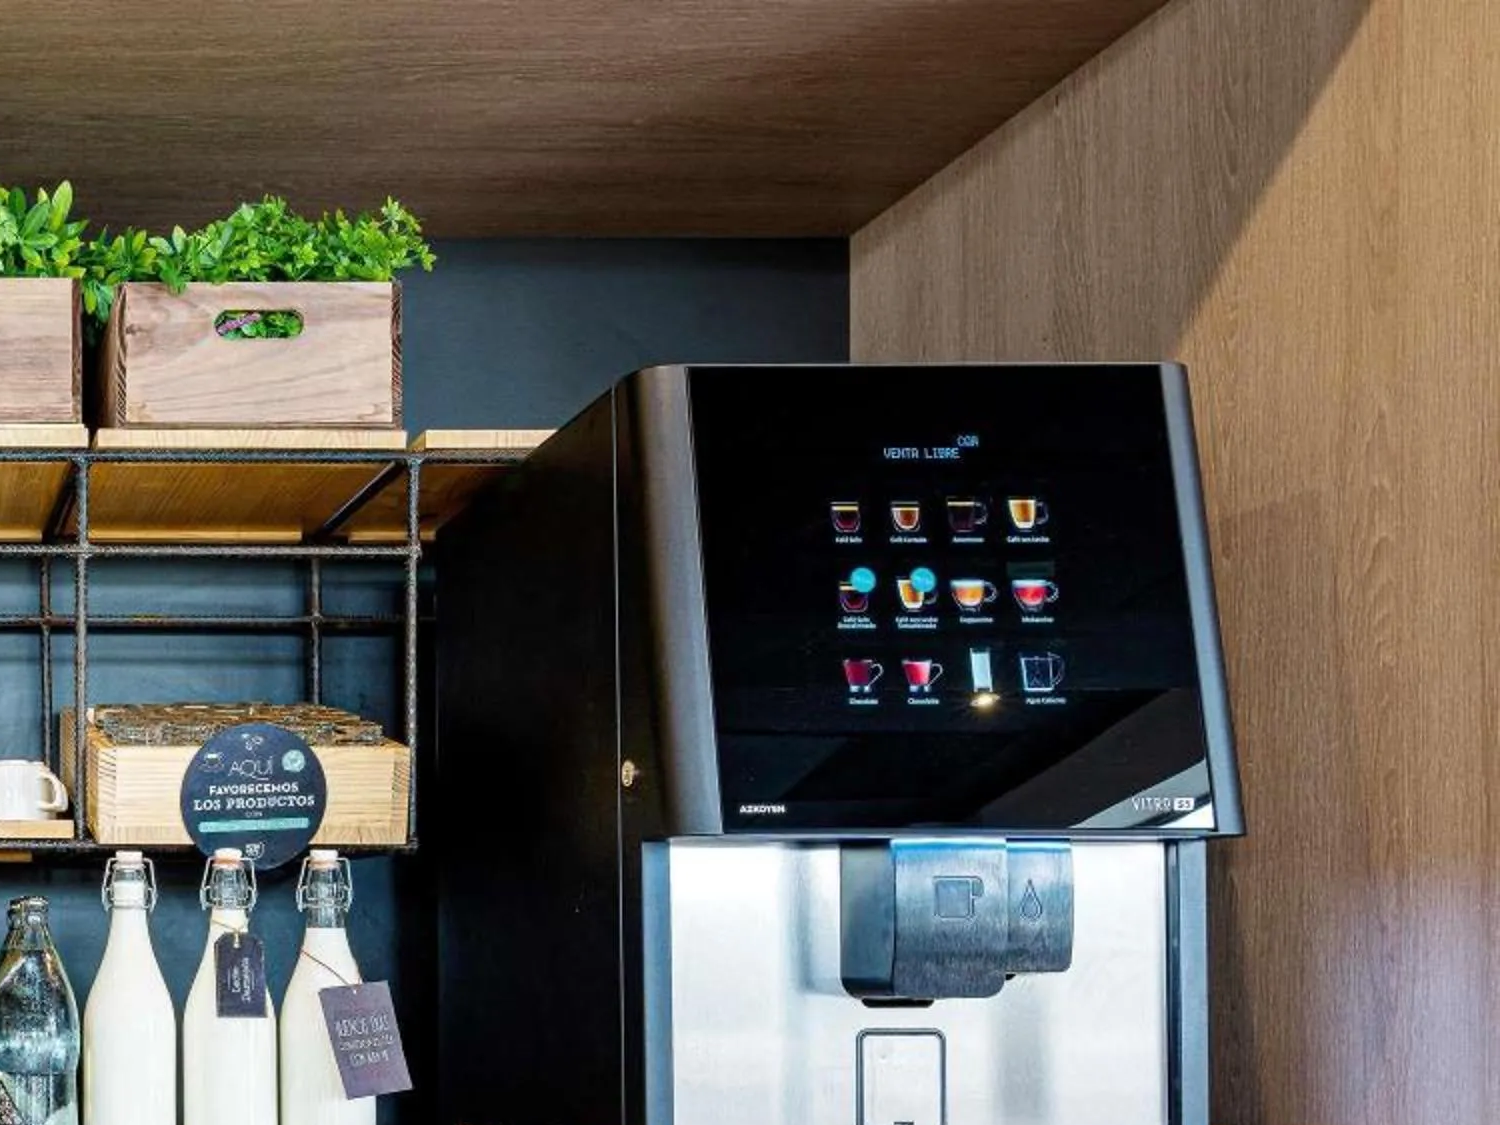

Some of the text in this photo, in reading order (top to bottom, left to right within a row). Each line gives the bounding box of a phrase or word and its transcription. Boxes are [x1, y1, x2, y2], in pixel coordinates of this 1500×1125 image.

[883, 447, 960, 459] VENTA LIBRE
[227, 755, 274, 781] AQUÍ
[209, 781, 299, 796] FAVORECEMOS
[194, 795, 315, 811] LOS PRODUCTOS
